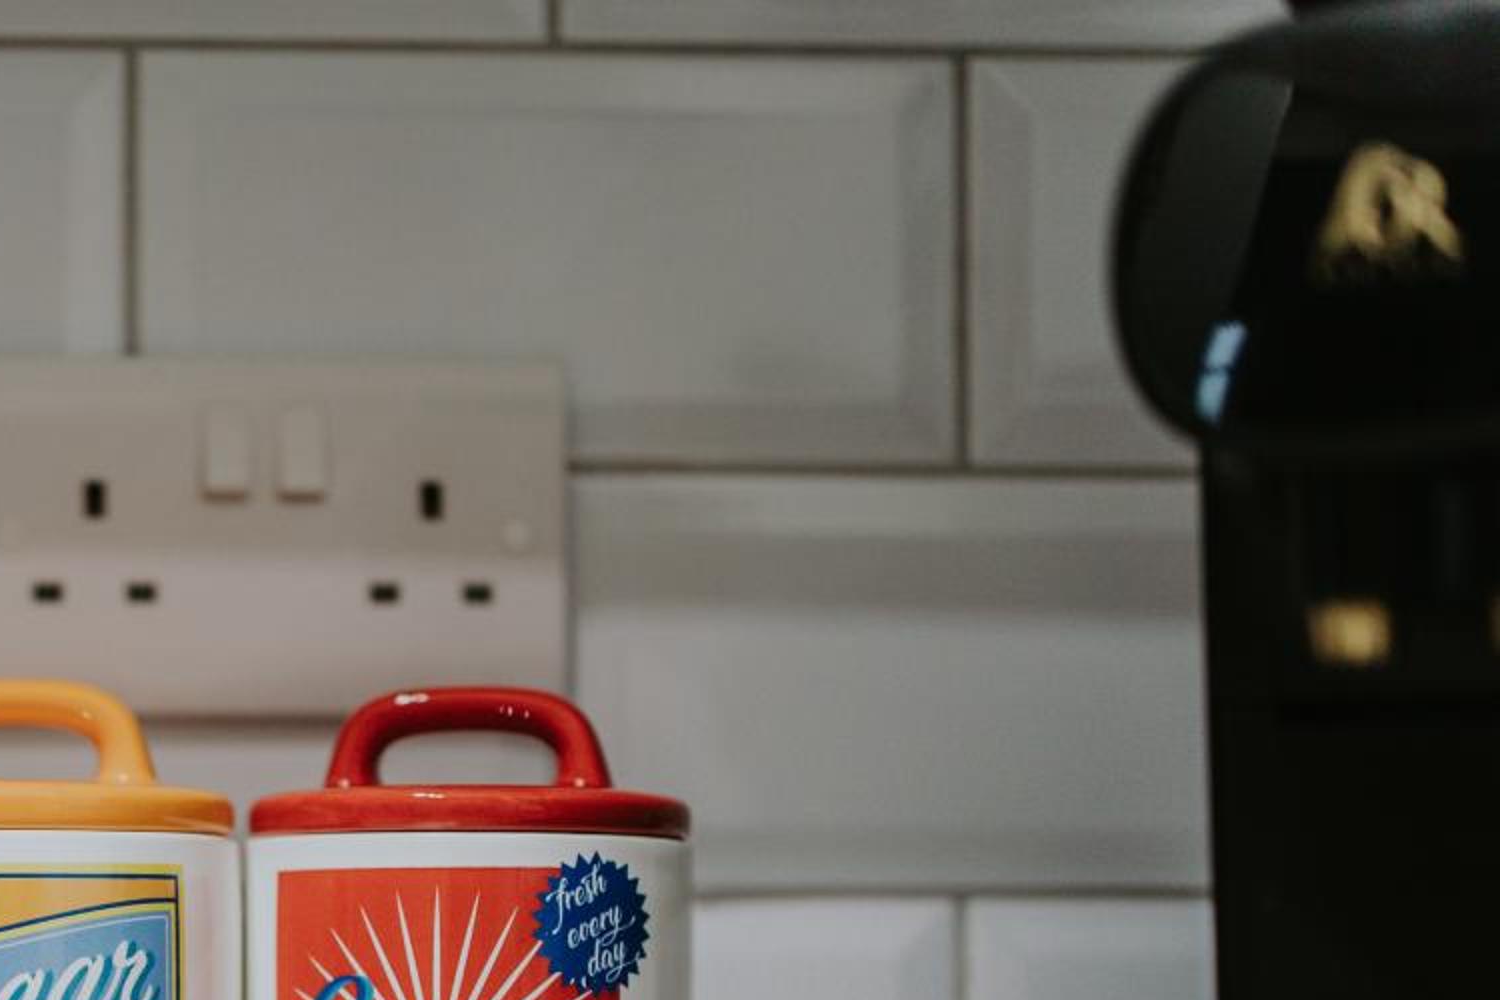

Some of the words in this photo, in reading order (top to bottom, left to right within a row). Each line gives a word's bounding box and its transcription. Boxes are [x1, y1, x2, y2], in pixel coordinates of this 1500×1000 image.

[544, 863, 607, 935] fresh
[567, 905, 635, 949] every
[587, 938, 640, 983] day
